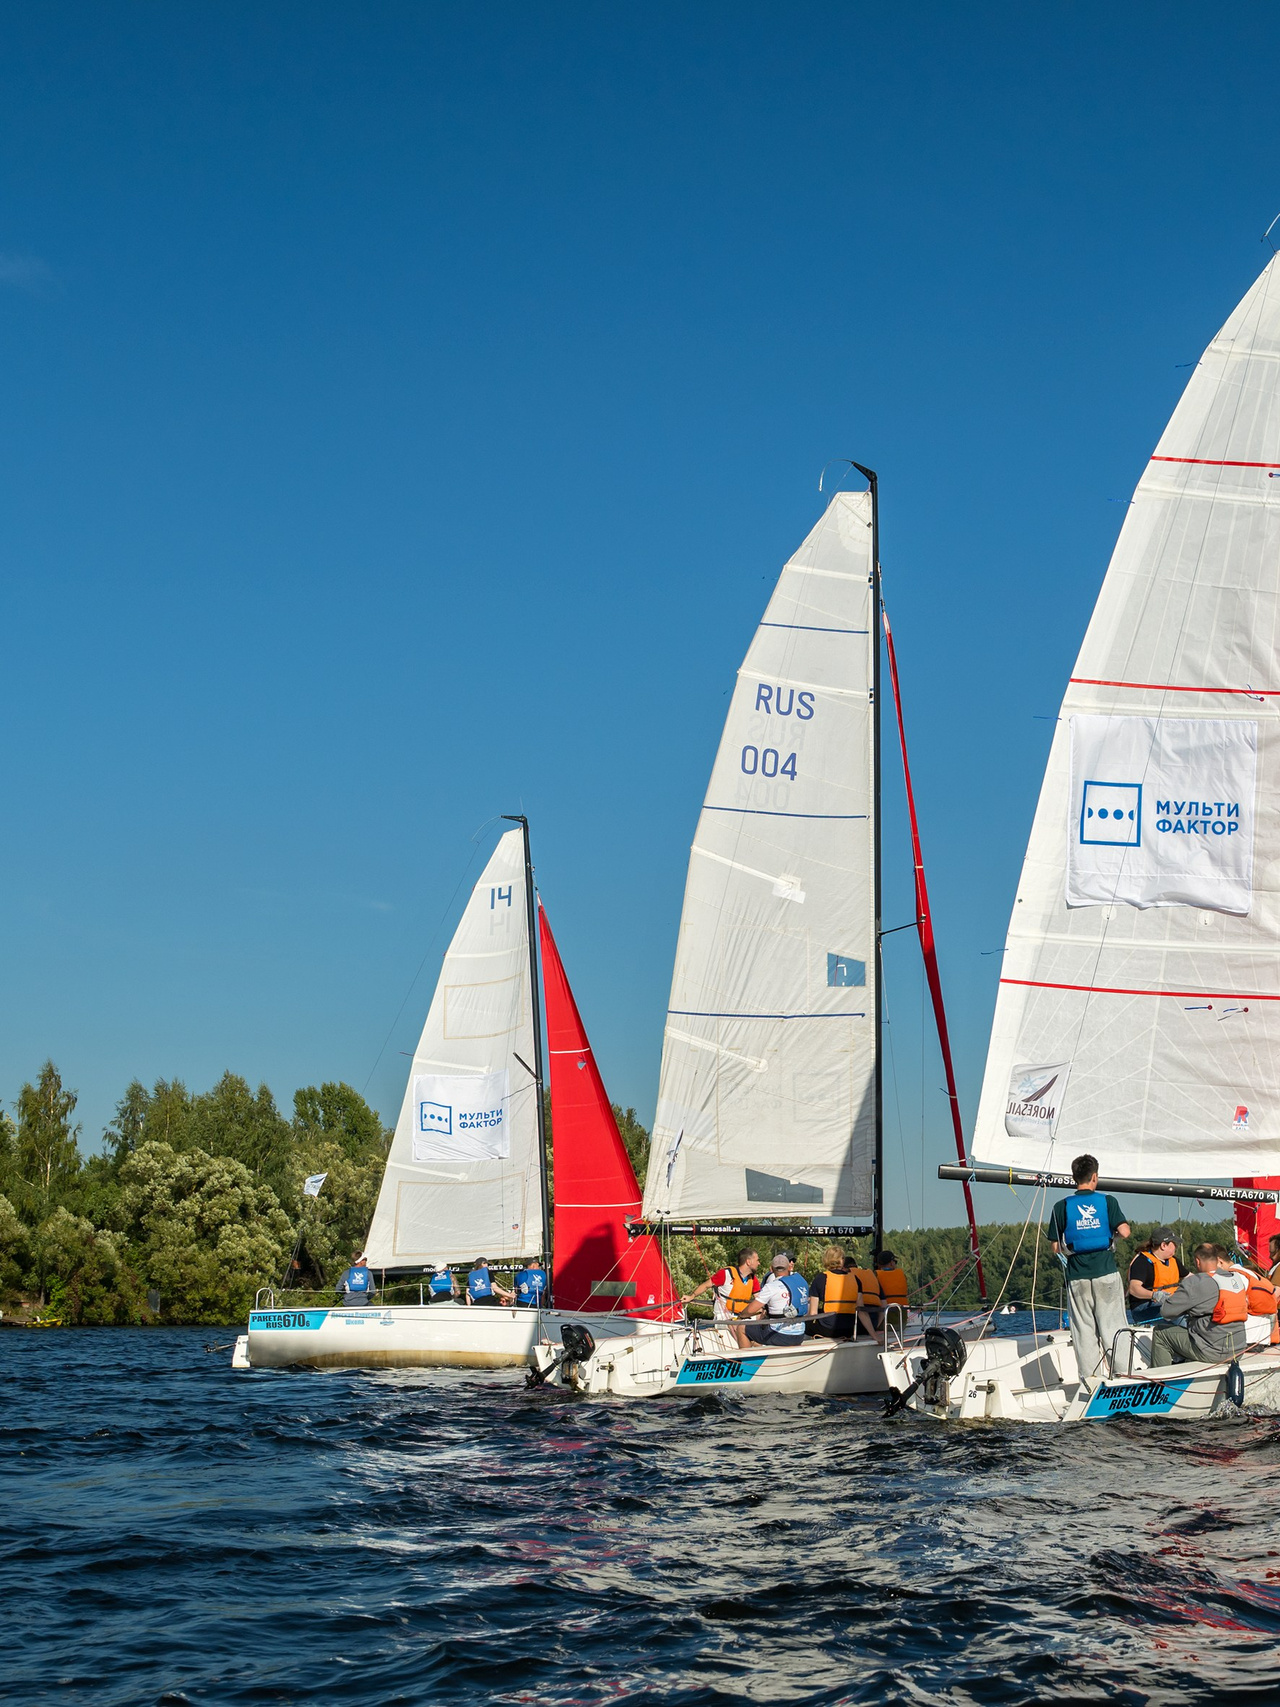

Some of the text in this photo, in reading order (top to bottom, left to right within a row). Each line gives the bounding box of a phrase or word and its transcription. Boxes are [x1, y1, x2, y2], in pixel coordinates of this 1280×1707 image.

[755, 683, 815, 720] RUS
[741, 745, 797, 781] 004
[1156, 800, 1239, 818] МУЛЬТИ
[1156, 818, 1239, 836] ФАКТОР
[490, 885, 512, 909] 14
[459, 1108, 502, 1120] МУЛЬТИ
[459, 1118, 502, 1129] ФАКТОР
[700, 1225, 741, 1233] moresail.ru
[838, 1227, 854, 1235] 670
[266, 1321, 283, 1329] RUS
[282, 1313, 305, 1328] 670
[695, 1370, 715, 1381] RUS
[968, 1389, 978, 1399] 26
[1131, 1382, 1166, 1407] 670
[1108, 1397, 1132, 1410] RUS
